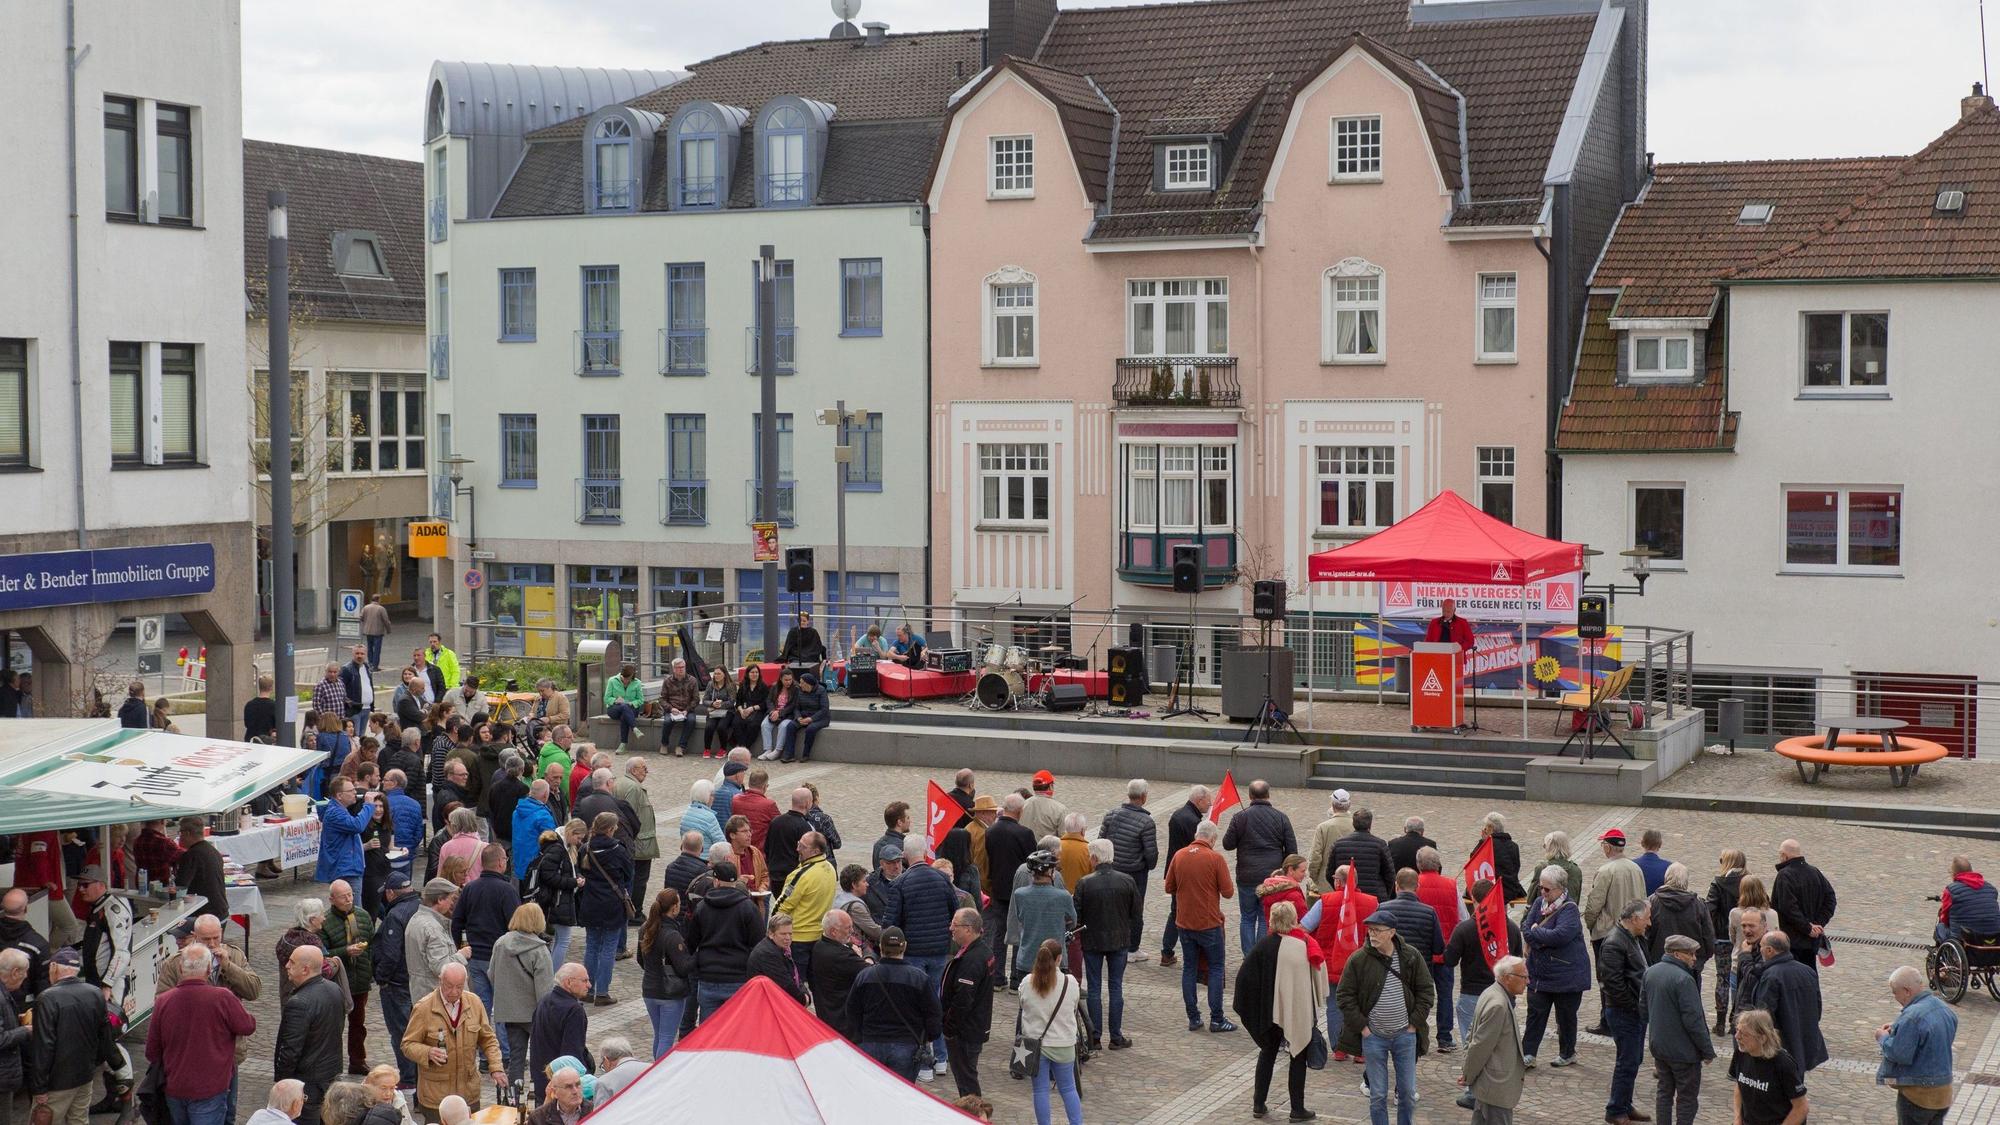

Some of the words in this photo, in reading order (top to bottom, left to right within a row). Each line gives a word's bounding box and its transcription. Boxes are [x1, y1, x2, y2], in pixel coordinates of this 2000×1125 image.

[416, 525, 447, 536] ADAC
[24, 573, 36, 590] &
[40, 570, 88, 589] Bender
[92, 564, 163, 585] Immobilien
[166, 563, 210, 583] Gruppe
[1416, 586, 1469, 598] NIEMALS
[1472, 587, 1542, 600] VERGESSEN
[1416, 597, 1434, 608] FÜR
[1437, 599, 1468, 609] IER
[1470, 600, 1501, 610] GEGEN
[1255, 607, 1273, 615] MIPRO
[1737, 1072, 1769, 1092] Respekt!
